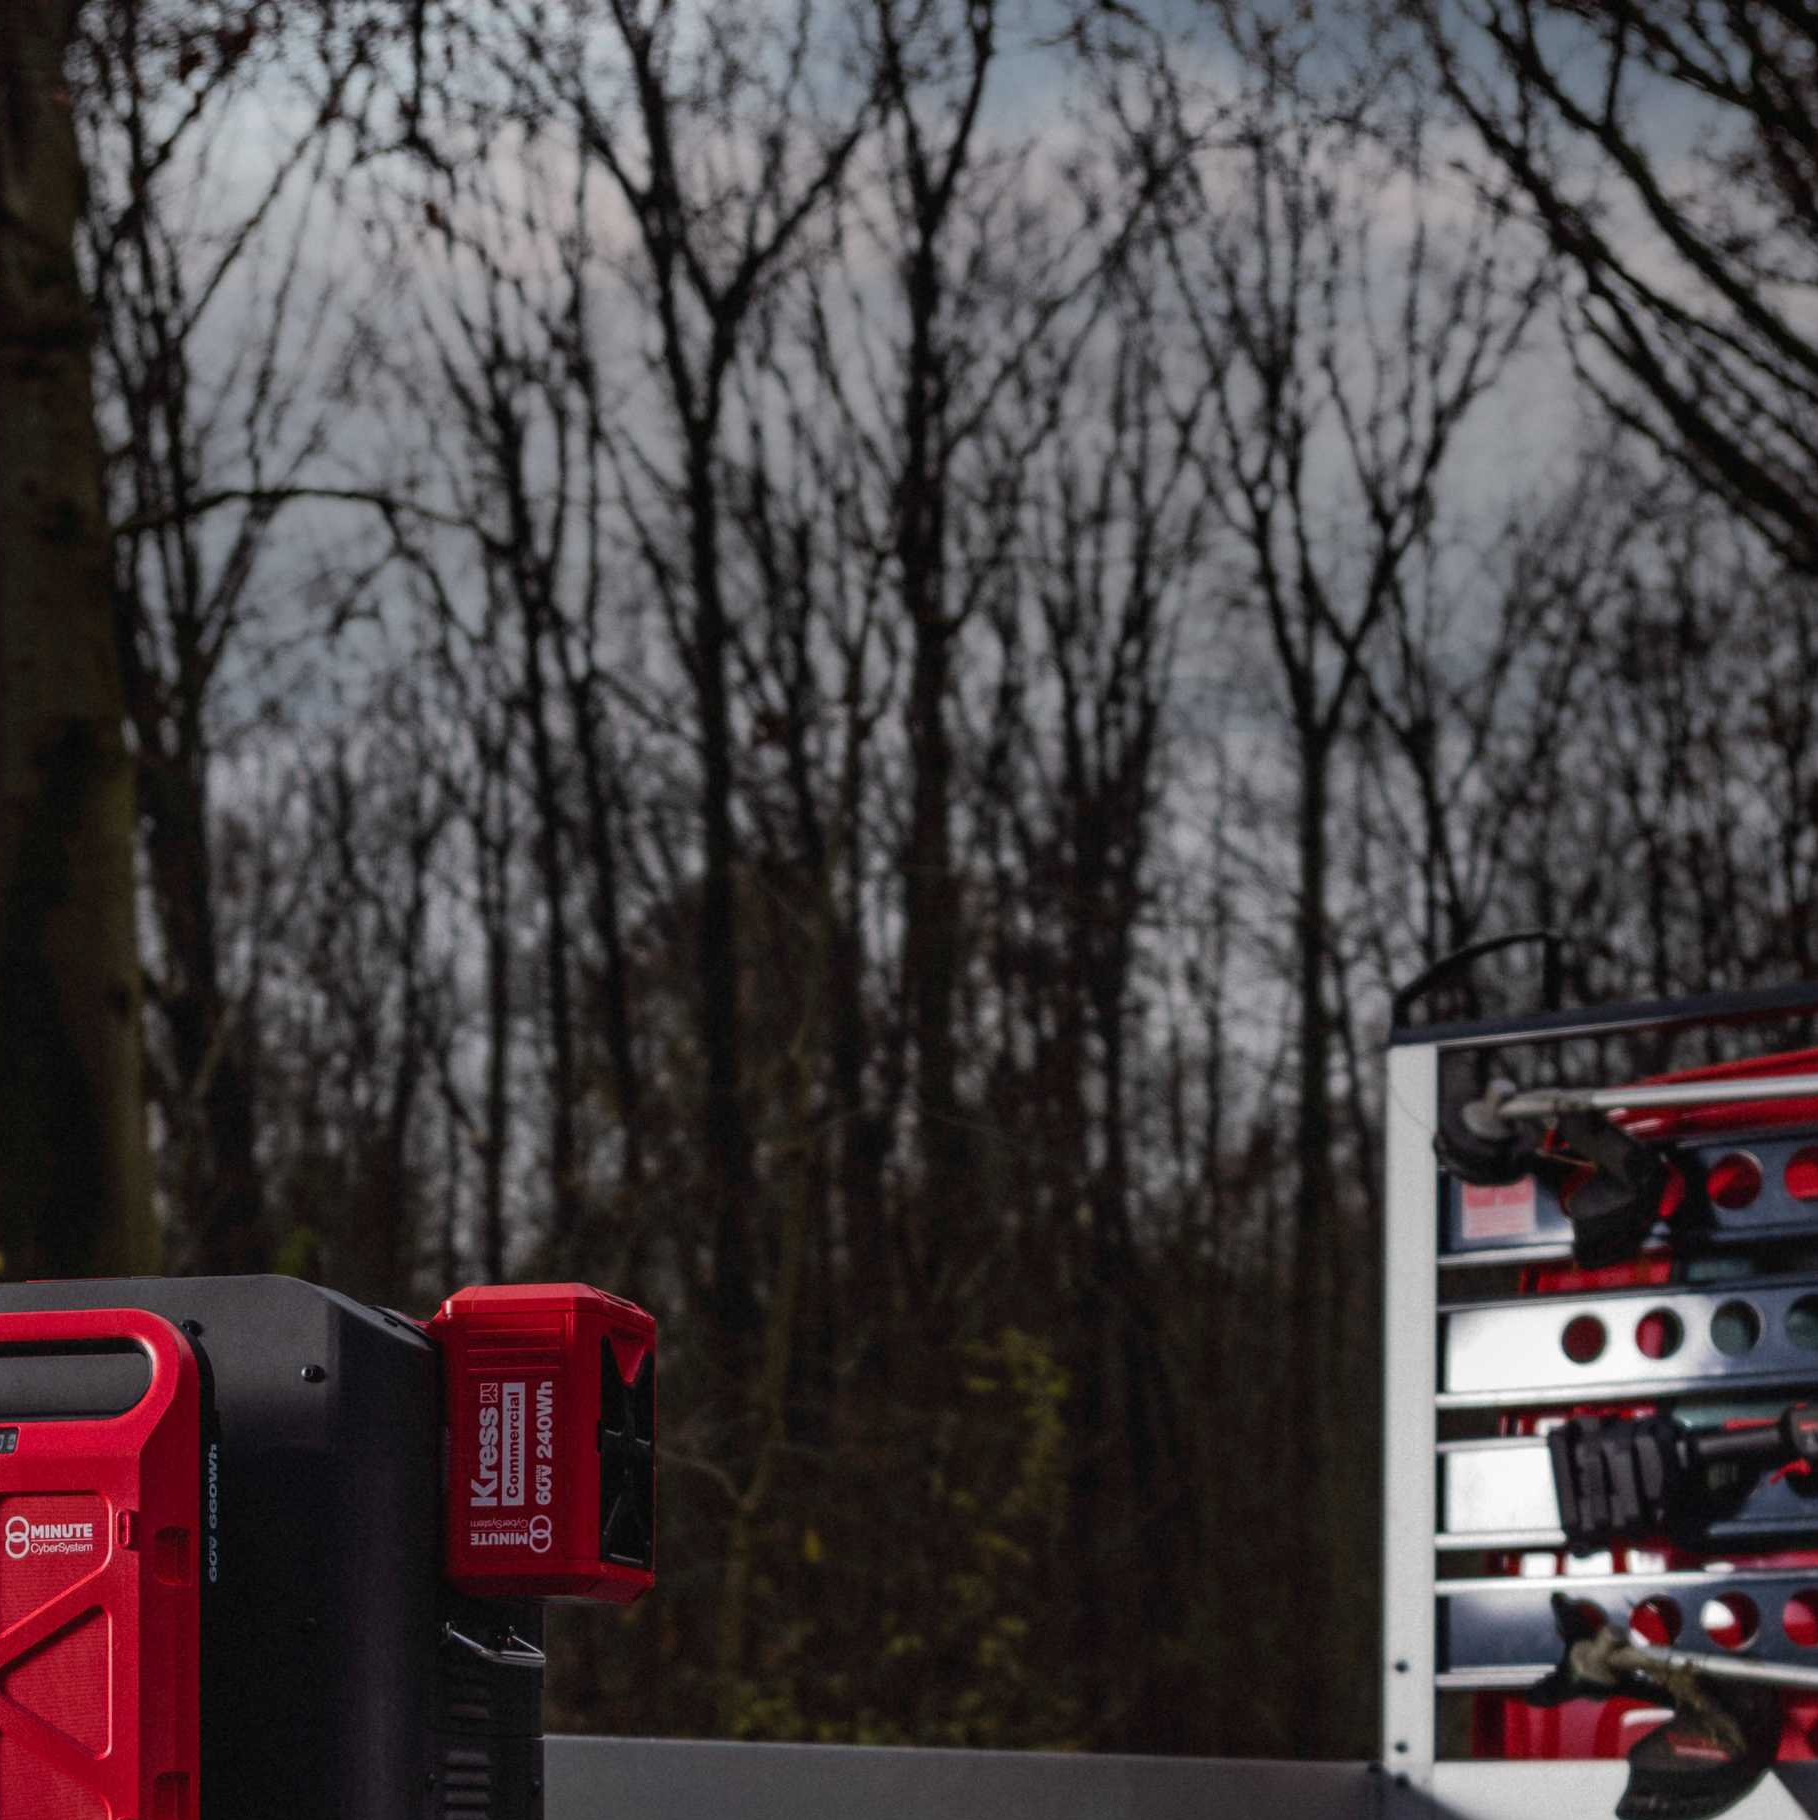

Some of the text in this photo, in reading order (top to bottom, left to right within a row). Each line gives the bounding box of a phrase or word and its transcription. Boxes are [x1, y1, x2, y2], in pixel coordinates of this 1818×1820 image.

[470, 1406, 499, 1507] Kress
[506, 1391, 521, 1498] Commercial
[535, 1381, 553, 1459] 240Wh
[30, 1523, 93, 1539] MINUTE
[30, 1542, 93, 1555] CyberSystem
[208, 1444, 218, 1584] 60V 660Wh
[471, 1533, 530, 1546] MINUTE
